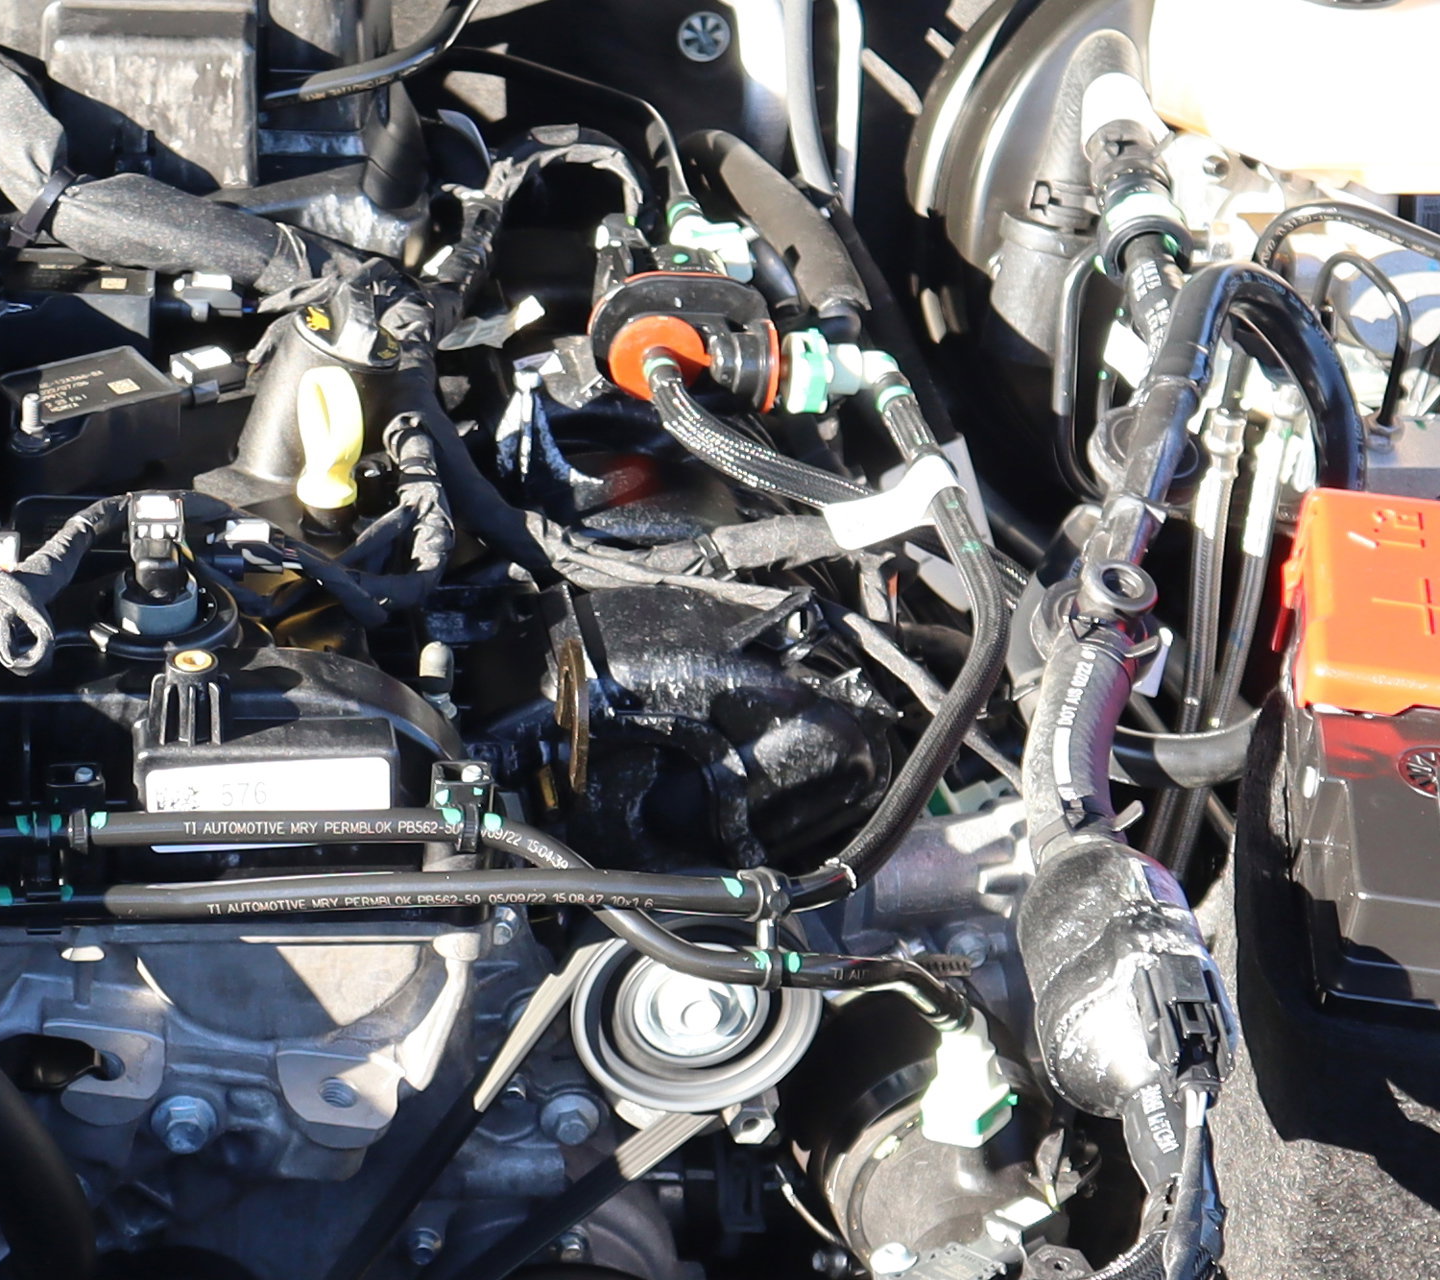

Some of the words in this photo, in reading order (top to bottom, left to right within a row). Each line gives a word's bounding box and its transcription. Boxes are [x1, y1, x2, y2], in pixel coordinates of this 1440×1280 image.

[221, 781, 267, 807] 576
[202, 821, 286, 836] AUTOMOTIVE
[290, 821, 319, 835] MRY
[324, 821, 393, 835] PERMBLOK
[227, 898, 306, 914] AUTOMOTIVE
[311, 898, 339, 910] MRY
[344, 895, 412, 908] PERMBLOK
[488, 893, 547, 905] 05/09/22
